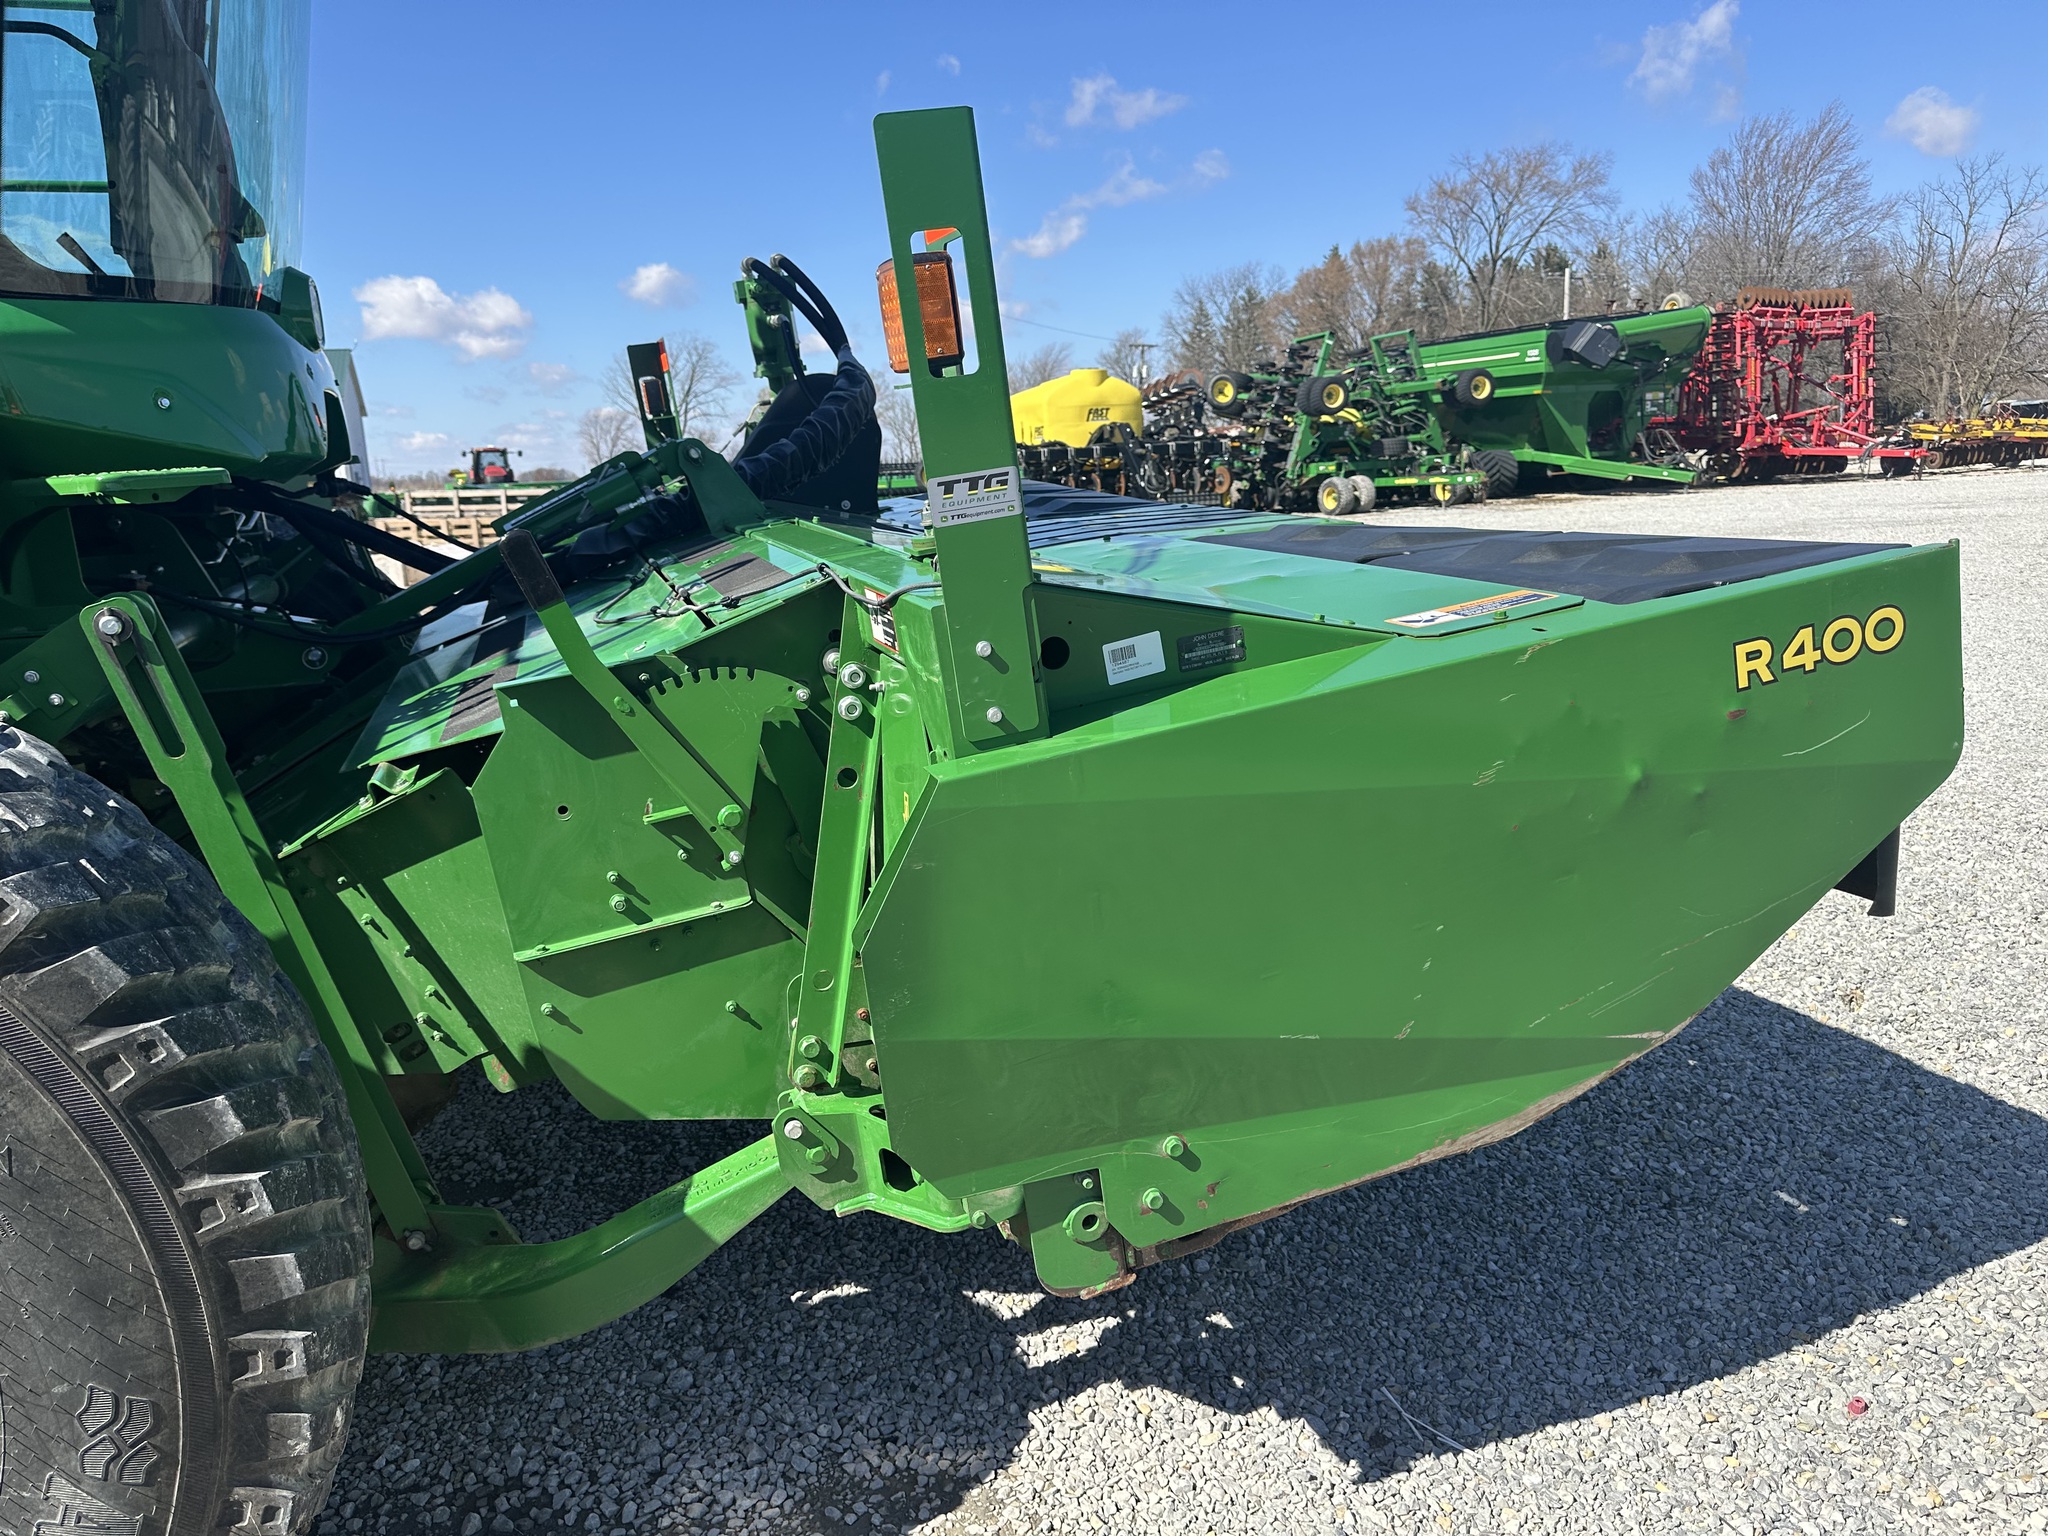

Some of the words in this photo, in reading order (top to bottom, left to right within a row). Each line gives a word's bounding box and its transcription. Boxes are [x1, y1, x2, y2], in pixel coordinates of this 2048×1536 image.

[1086, 407, 1111, 422] FAST
[937, 471, 1010, 500] TTG
[941, 492, 1008, 509] EQUIPMENT
